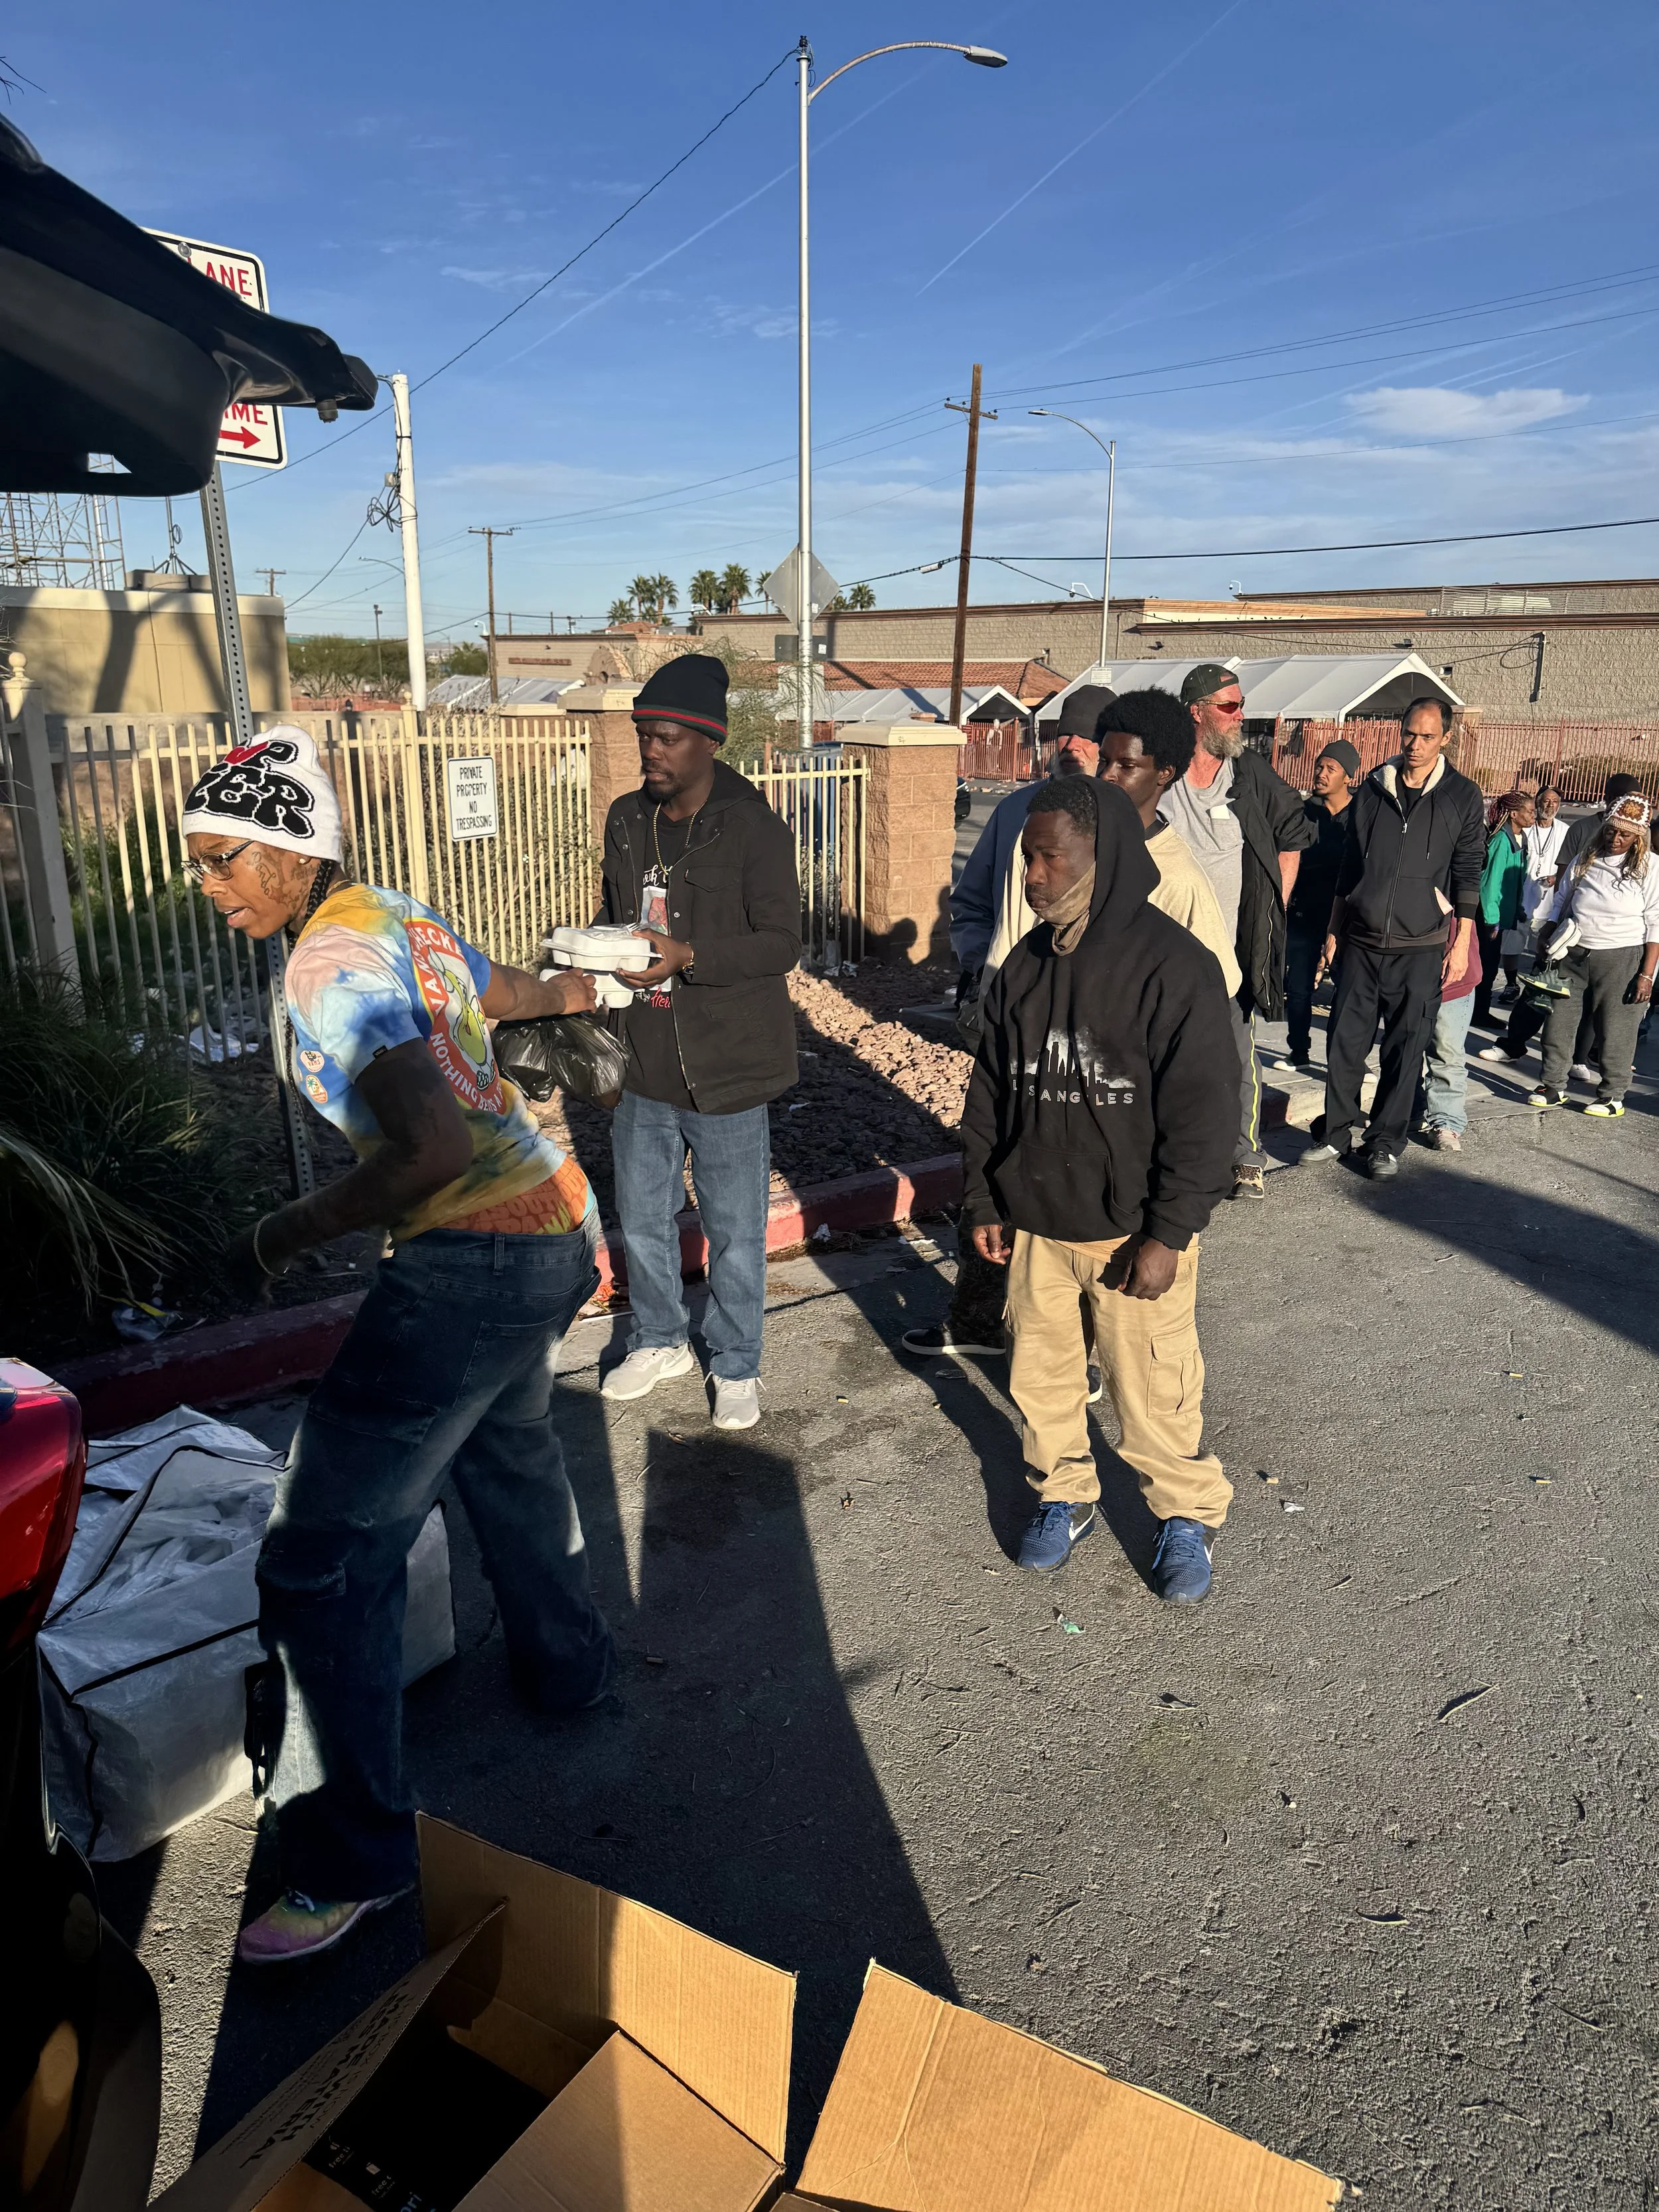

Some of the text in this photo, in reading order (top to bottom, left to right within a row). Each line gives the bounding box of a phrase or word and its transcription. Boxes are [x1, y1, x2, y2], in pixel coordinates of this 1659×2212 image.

[188, 257, 252, 296] ANE
[460, 766, 482, 780] PRIVATE
[457, 782, 487, 797] PROPERTY
[469, 800, 477, 814] NO
[456, 815, 492, 831] TRESPASSING
[408, 926, 463, 954] CHECKE
[430, 1032, 478, 1103] NOTHING
[1013, 1079, 1133, 1106] LS ANGLES
[358, 1980, 410, 2039] LESS
[346, 1993, 409, 2069] MADE
[240, 2043, 361, 2169] MATERIAL
[281, 2072, 350, 2142] WITH
[309, 2089, 348, 2129] NOW
[328, 2153, 345, 2169] free
[371, 2180, 388, 2196] free
